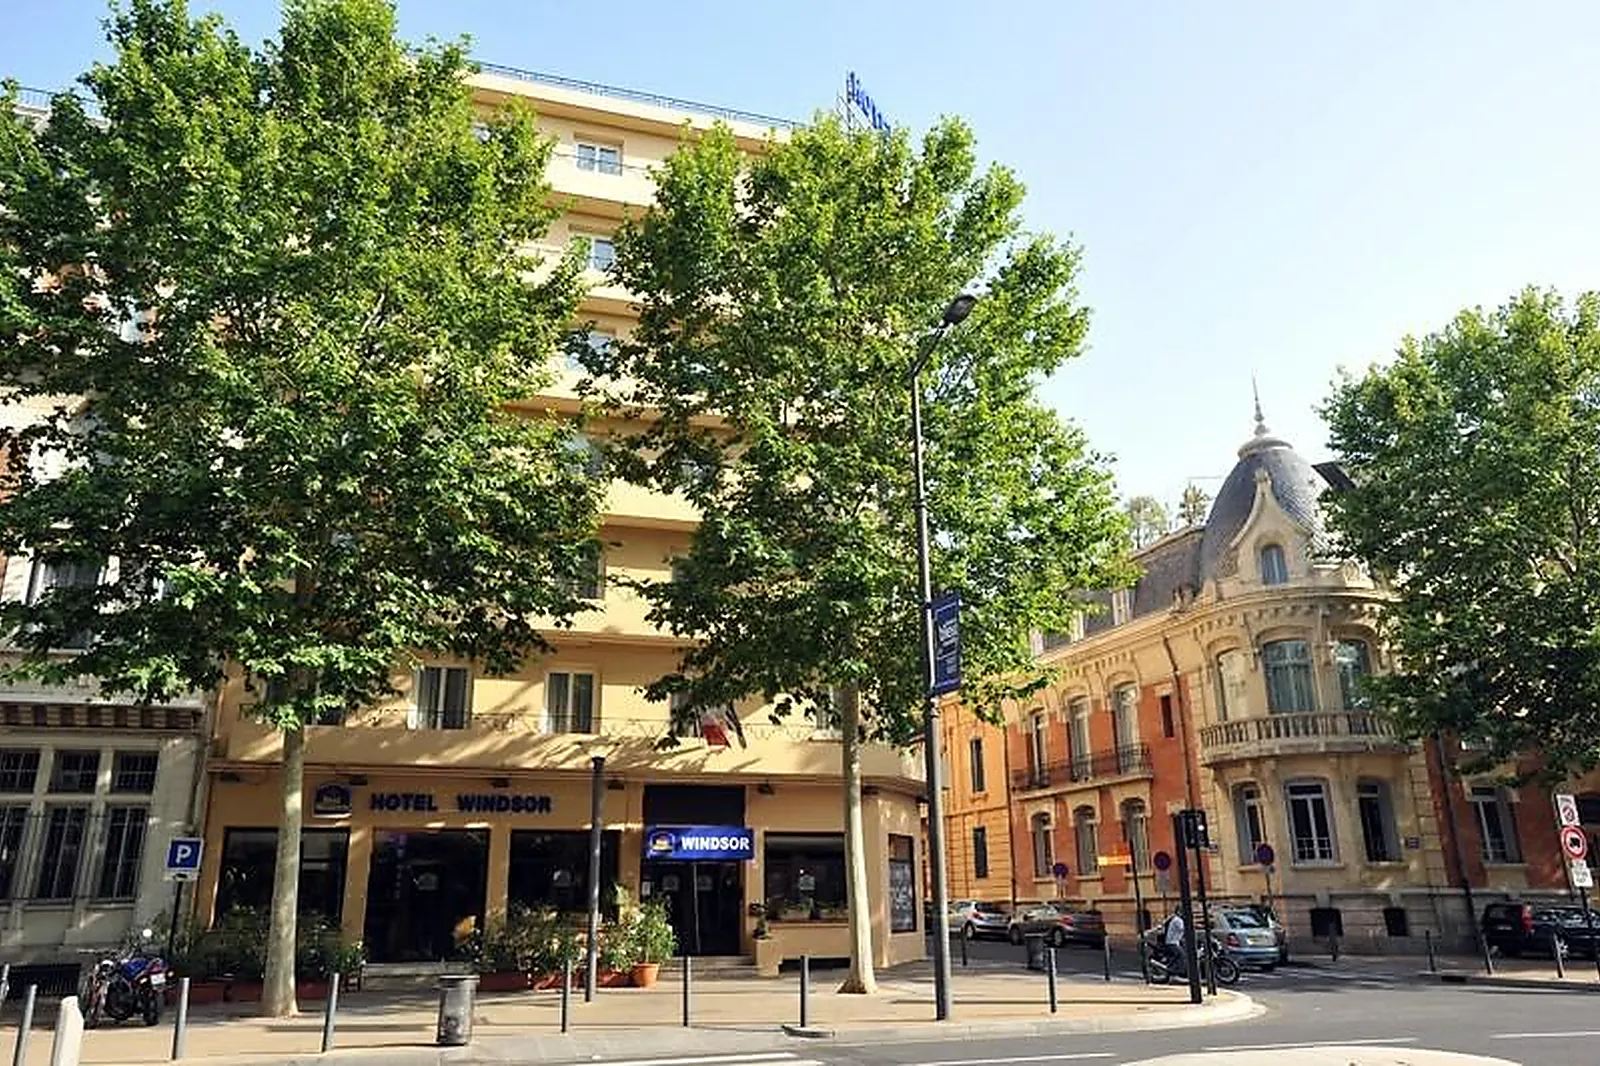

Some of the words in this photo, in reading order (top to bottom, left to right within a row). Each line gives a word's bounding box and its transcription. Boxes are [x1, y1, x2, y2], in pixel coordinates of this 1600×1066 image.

[370, 792, 438, 812] HOTEL
[456, 794, 552, 813] WINDSOR
[681, 836, 750, 851] WINDSOR
[175, 844, 192, 864] P
